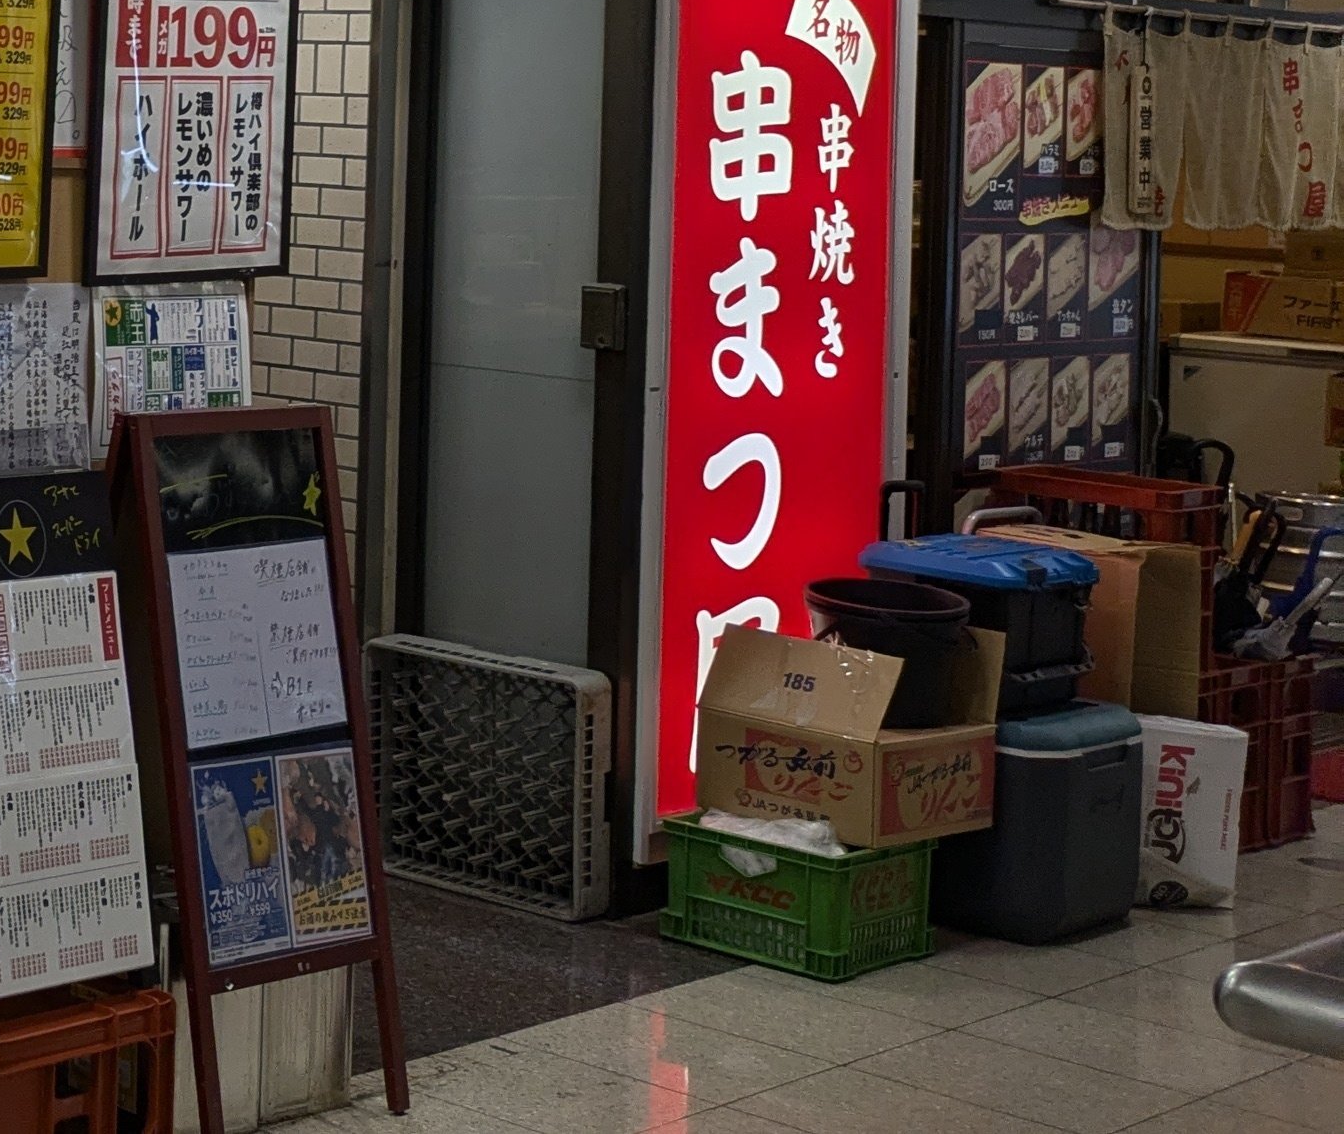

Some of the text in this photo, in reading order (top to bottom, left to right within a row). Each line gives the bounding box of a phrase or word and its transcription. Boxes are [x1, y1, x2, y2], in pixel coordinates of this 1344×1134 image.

[157, 19, 169, 55] メガ
[170, 5, 276, 69] 199円
[128, 94, 153, 242] ハイボール
[175, 92, 194, 243] レモンサワー
[195, 91, 214, 193] 濃いめの
[229, 93, 248, 237] レモンサワー
[245, 91, 264, 231] 樽ハイ倶楽部の
[1139, 105, 1152, 191] 営業中
[988, 178, 1015, 194] ロース
[807, 103, 857, 379] 串焼き
[129, 301, 145, 344] 赤玉
[101, 583, 115, 656] フードメニュー
[782, 671, 817, 693] 185
[773, 772, 853, 801] りんご
[208, 878, 280, 910] スポドリハイ
